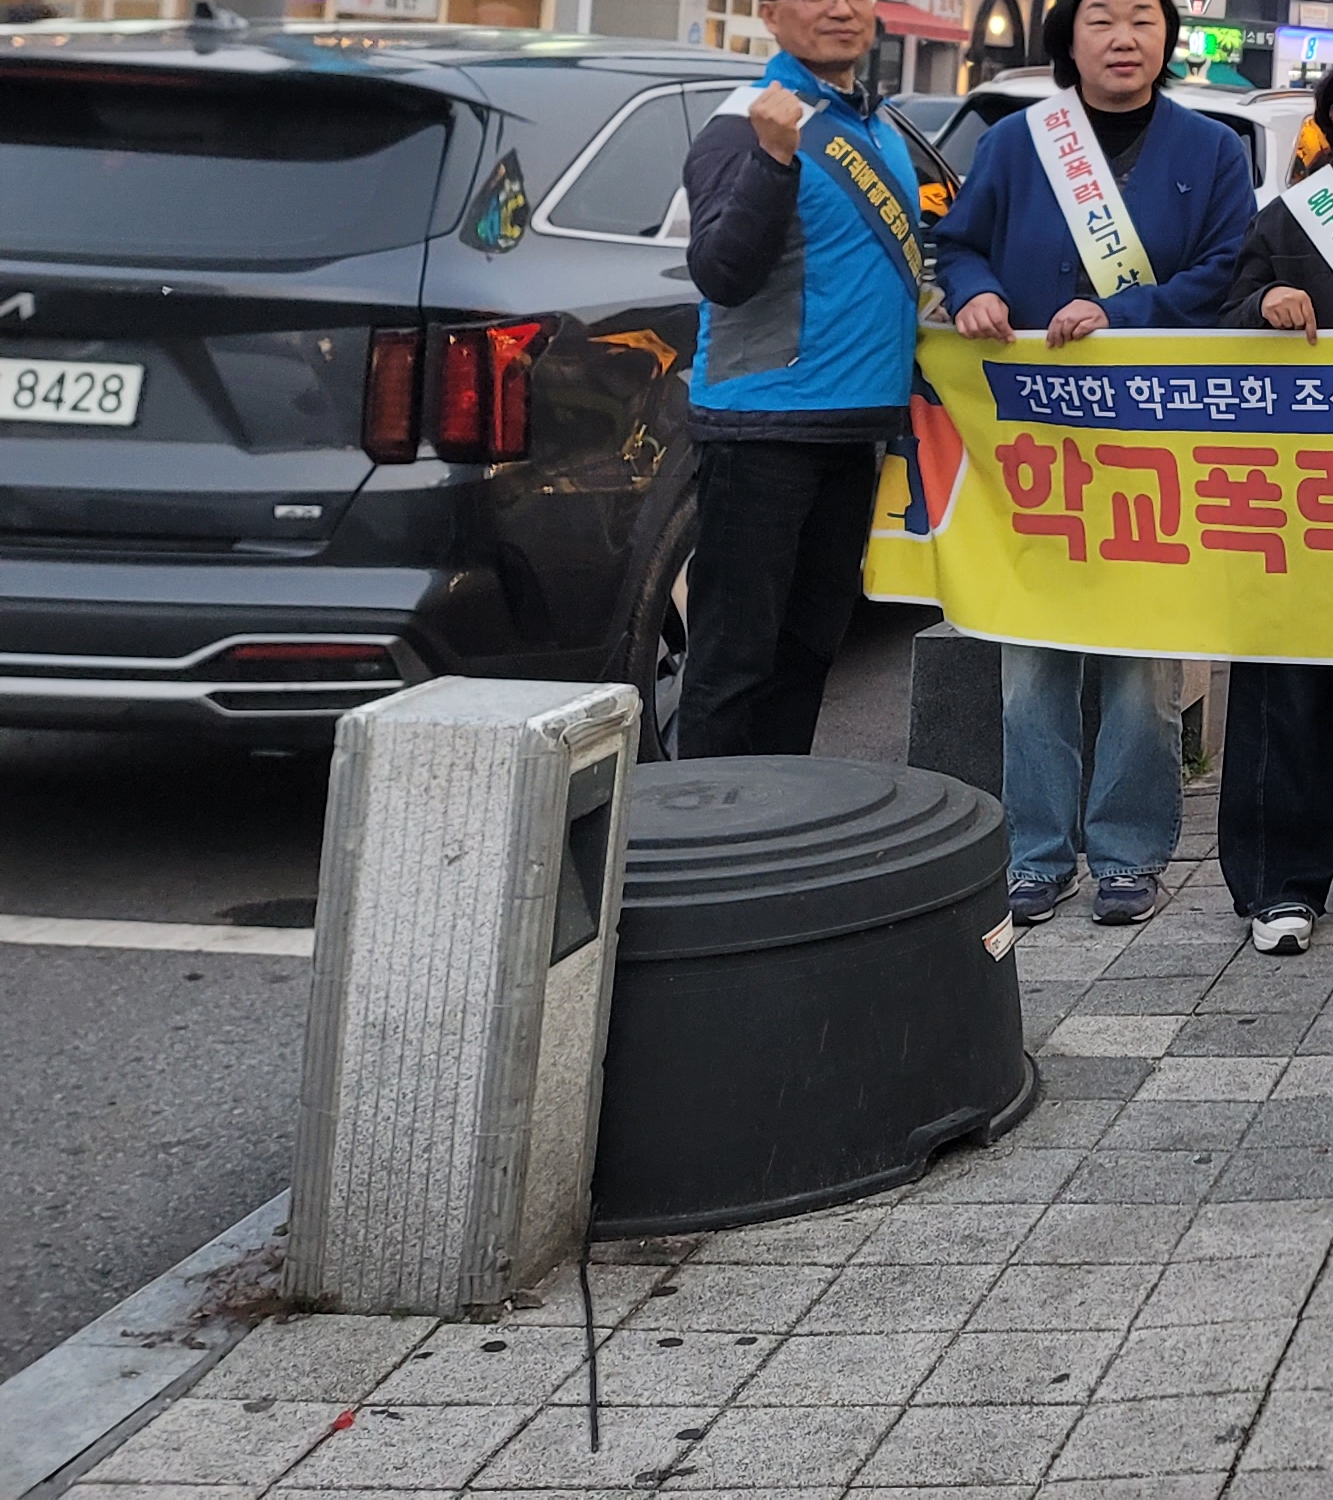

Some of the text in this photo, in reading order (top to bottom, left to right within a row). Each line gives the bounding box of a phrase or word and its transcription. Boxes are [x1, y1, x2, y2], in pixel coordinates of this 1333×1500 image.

[1042, 107, 1105, 206] 학교폭력
[13, 366, 126, 414] 8428
[1016, 375, 1116, 419] 건전한
[1127, 376, 1278, 419] 학교문화
